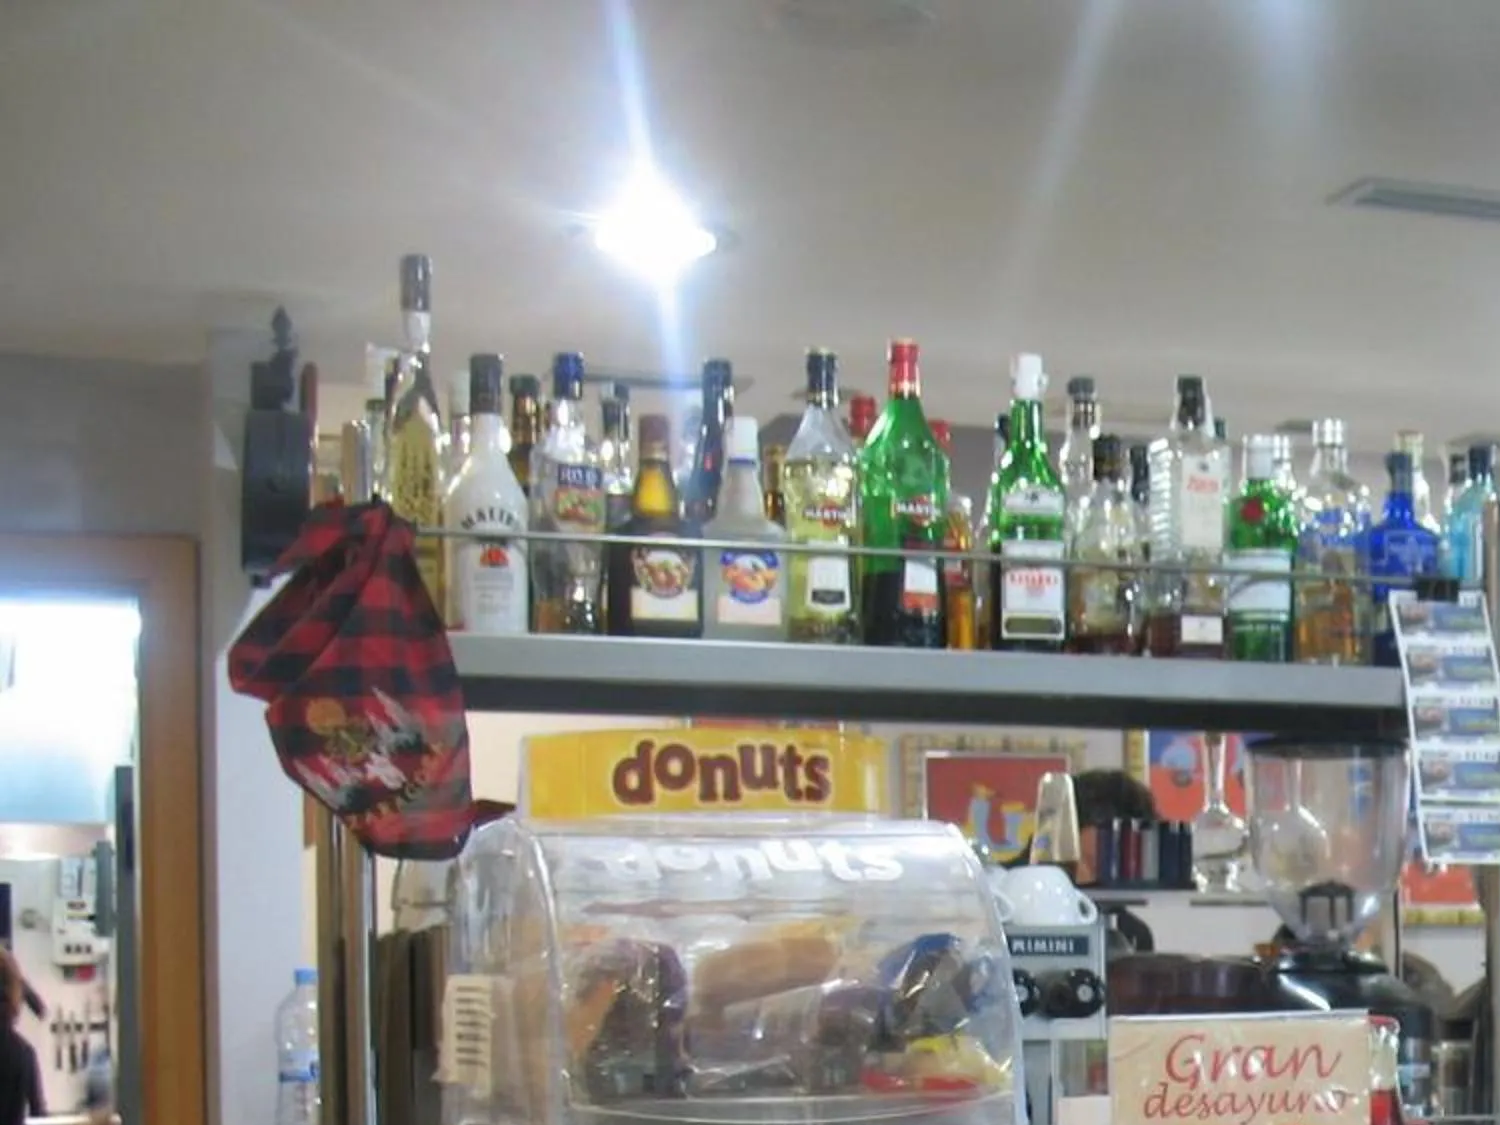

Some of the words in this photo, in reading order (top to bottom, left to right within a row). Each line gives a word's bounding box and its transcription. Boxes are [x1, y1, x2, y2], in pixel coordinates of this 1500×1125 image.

[612, 739, 833, 804] donuts
[1165, 1034, 1342, 1089] Gran
[1143, 1081, 1355, 1125] desayuno
